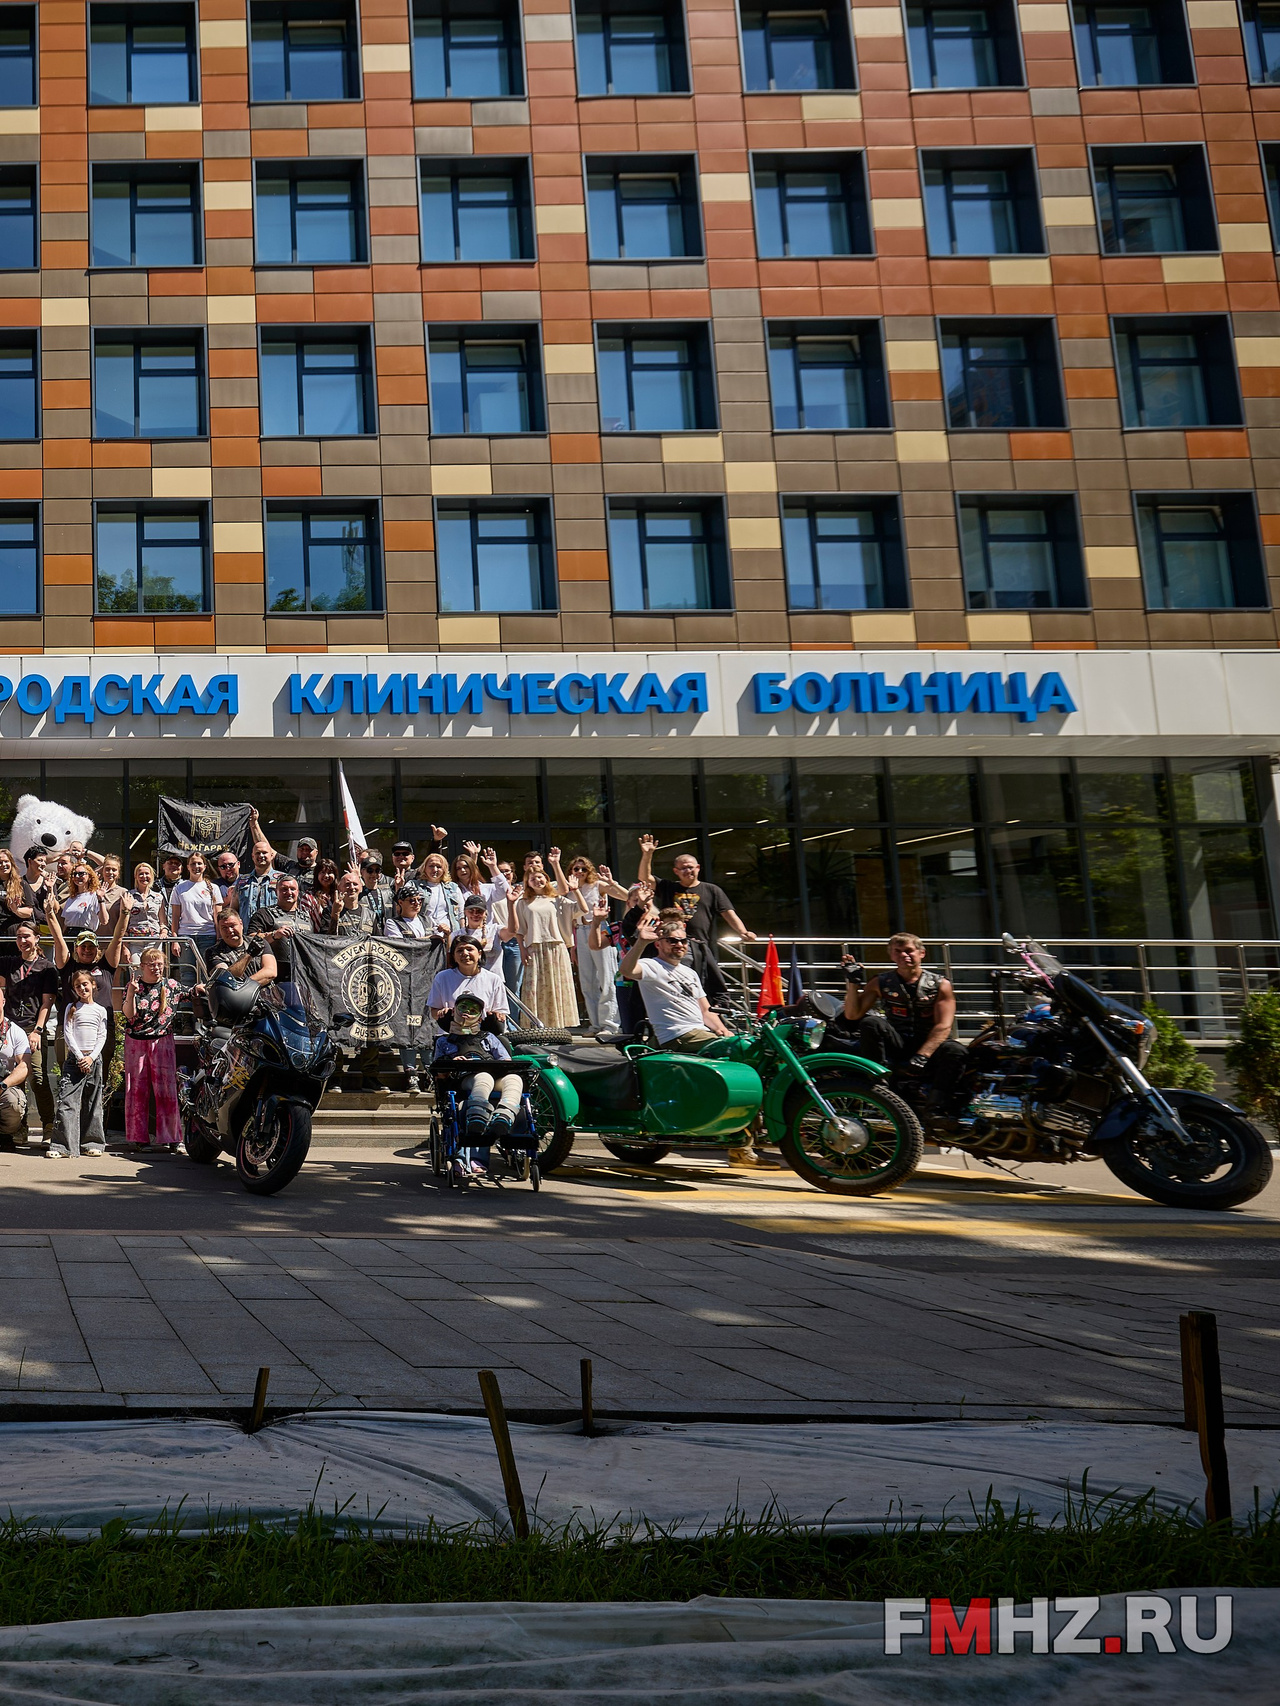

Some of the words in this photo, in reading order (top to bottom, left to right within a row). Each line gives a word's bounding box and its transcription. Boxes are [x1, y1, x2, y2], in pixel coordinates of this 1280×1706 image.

[289, 672, 709, 715] КЛИНИЧЕСКАЯ
[753, 672, 1078, 723] БОЛЬНИЦА
[337, 944, 366, 965] SEVEN
[371, 944, 403, 967] ROADS
[354, 1026, 388, 1038] RUSSIA
